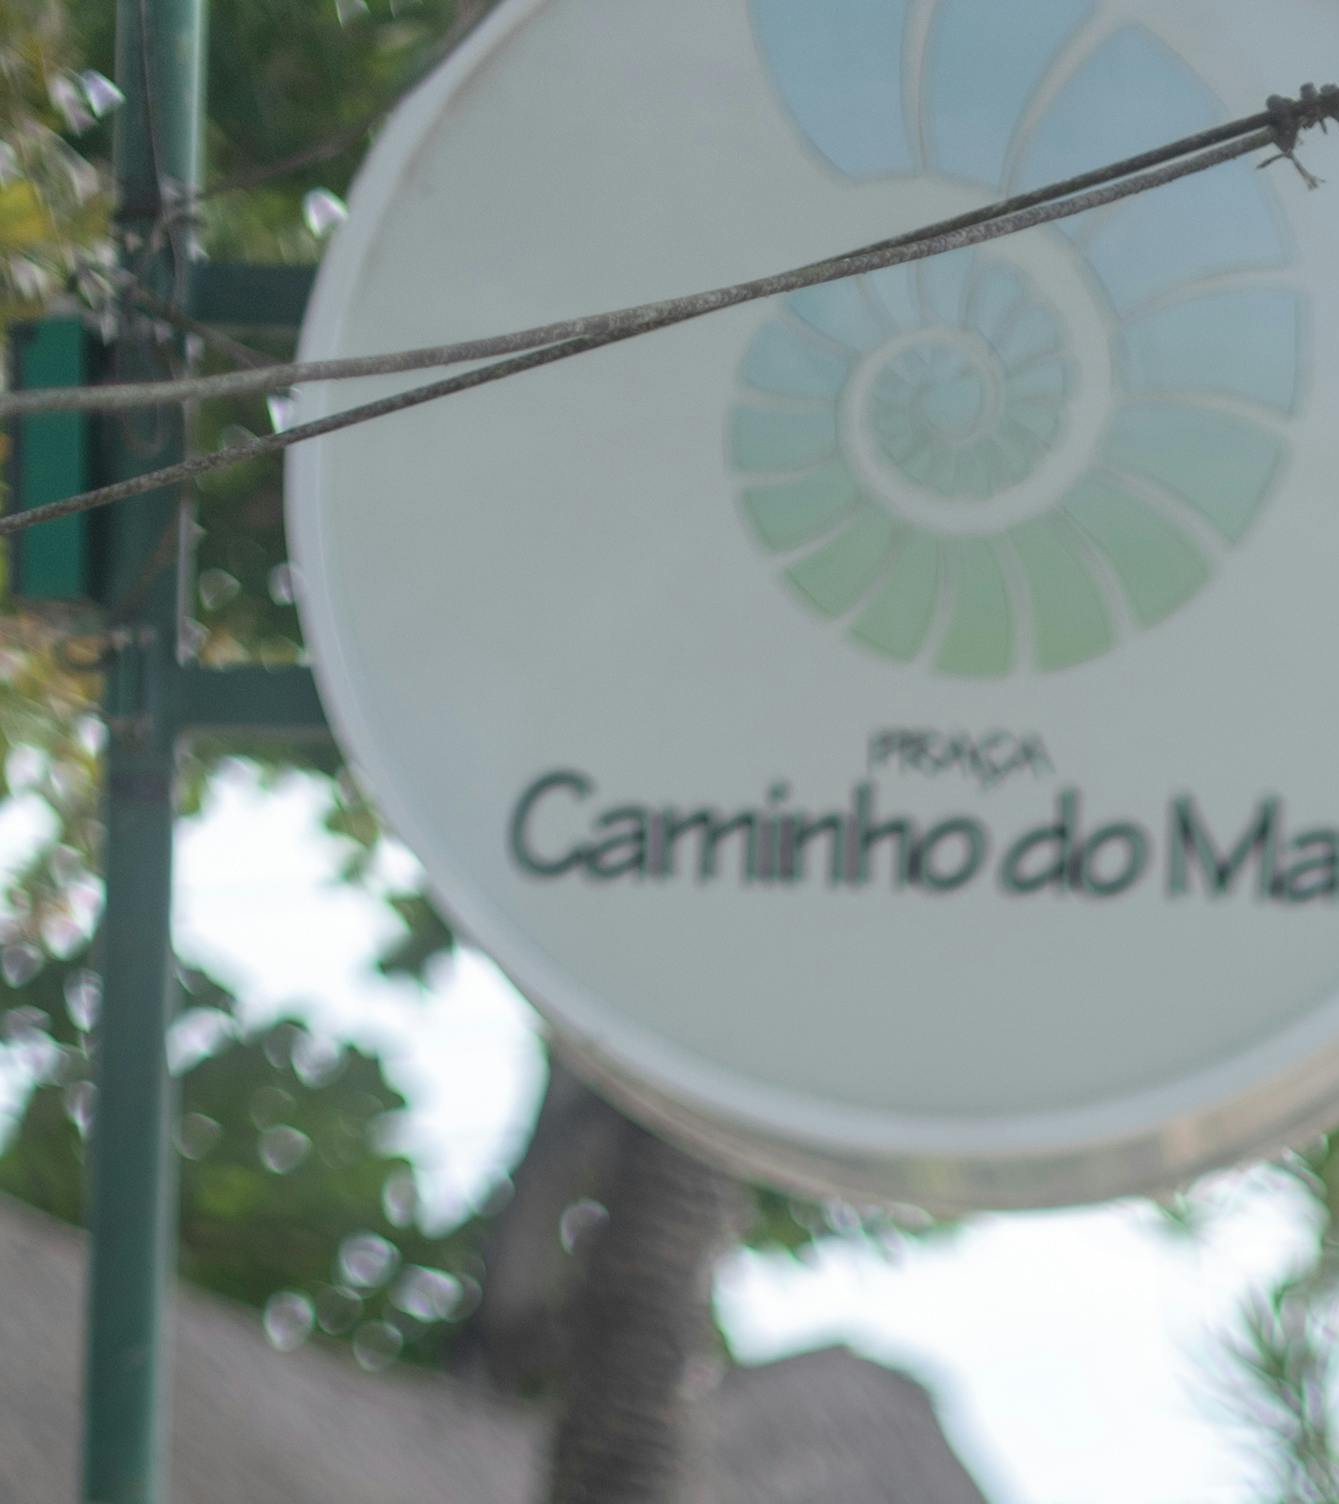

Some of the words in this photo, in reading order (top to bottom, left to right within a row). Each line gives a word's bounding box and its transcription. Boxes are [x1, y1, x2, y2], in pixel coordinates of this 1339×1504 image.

[869, 727, 1056, 788] PRAÇA
[510, 769, 989, 894] Caminho
[1000, 789, 1150, 897] do
